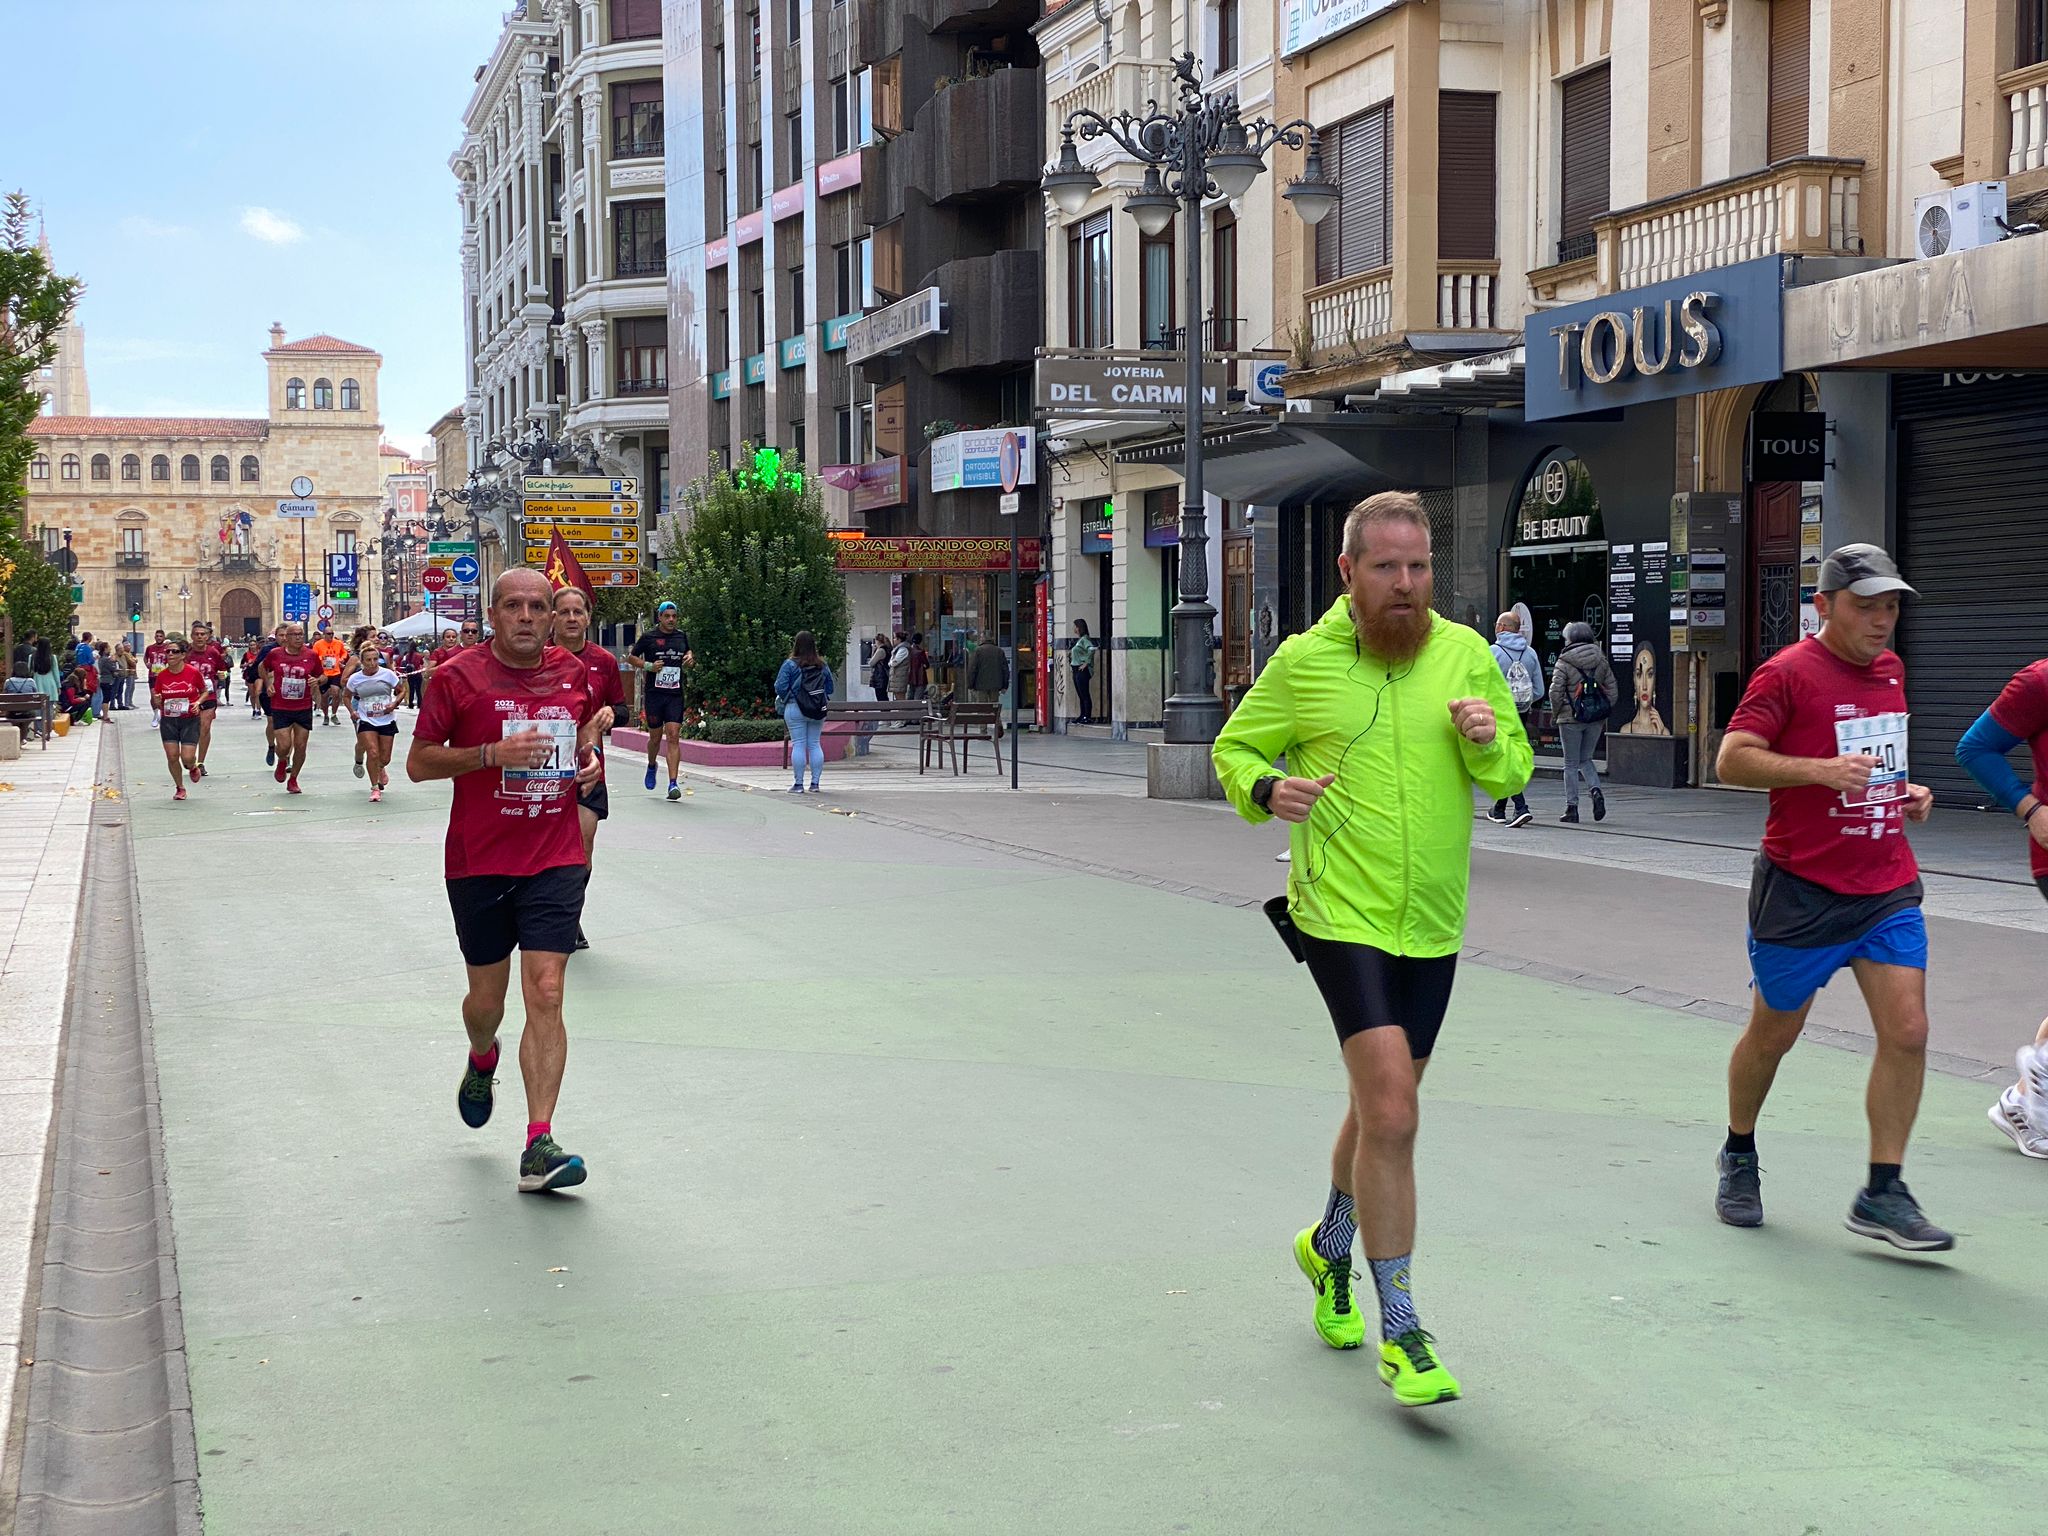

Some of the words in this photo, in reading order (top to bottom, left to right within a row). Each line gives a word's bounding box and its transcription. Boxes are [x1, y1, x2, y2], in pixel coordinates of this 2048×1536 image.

[1331, 11, 1342, 27] 987
[1343, 8, 1351, 20] 25
[1549, 290, 1722, 391] TOUS
[1103, 366, 1164, 378] JOYERIA
[1050, 383, 1097, 402] DEL
[1111, 383, 1216, 404] CARMN
[1759, 438, 1820, 455] TOUS
[965, 461, 1000, 471] ORTODONC
[965, 472, 996, 481] INVISIBLE
[1546, 472, 1563, 493] BE
[280, 503, 315, 513] Cámara
[527, 504, 553, 512] Conde
[527, 527, 544, 535] Luis
[562, 528, 582, 536] León
[1523, 520, 1540, 540] BE
[1541, 515, 1591, 539] BEAUTY
[424, 575, 446, 583] STOP
[1585, 606, 1602, 626] BE
[662, 673, 675, 681] 573
[529, 745, 560, 770] 21
